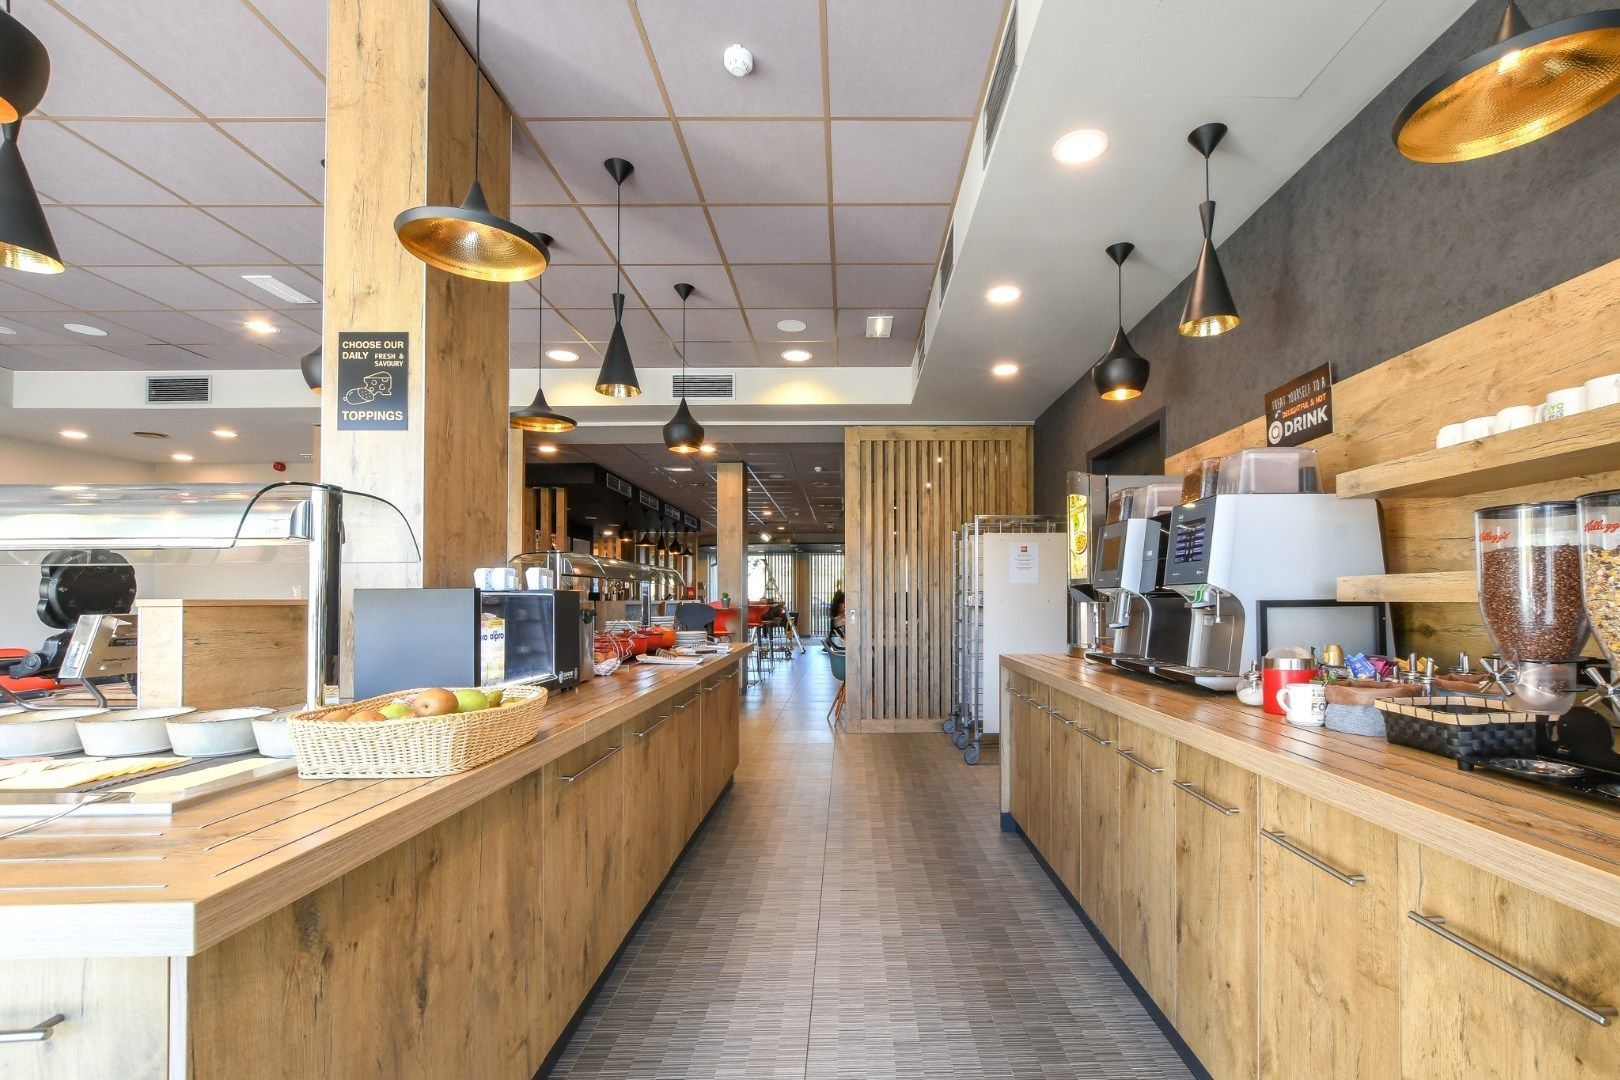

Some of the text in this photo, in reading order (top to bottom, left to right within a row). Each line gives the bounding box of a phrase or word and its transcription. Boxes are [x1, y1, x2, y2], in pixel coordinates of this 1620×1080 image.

[342, 340, 404, 349] CHOOSE OUR
[342, 351, 369, 360] DAILY
[1272, 376, 1326, 411] TREAT YOURSELF TO A
[1282, 402, 1309, 418] DELIGHTFUL
[1316, 393, 1326, 403] HOT
[341, 410, 403, 421] TOPPINGS
[1284, 404, 1328, 437] DRINK
[490, 630, 505, 642] alpro
[1311, 702, 1326, 711] FO
